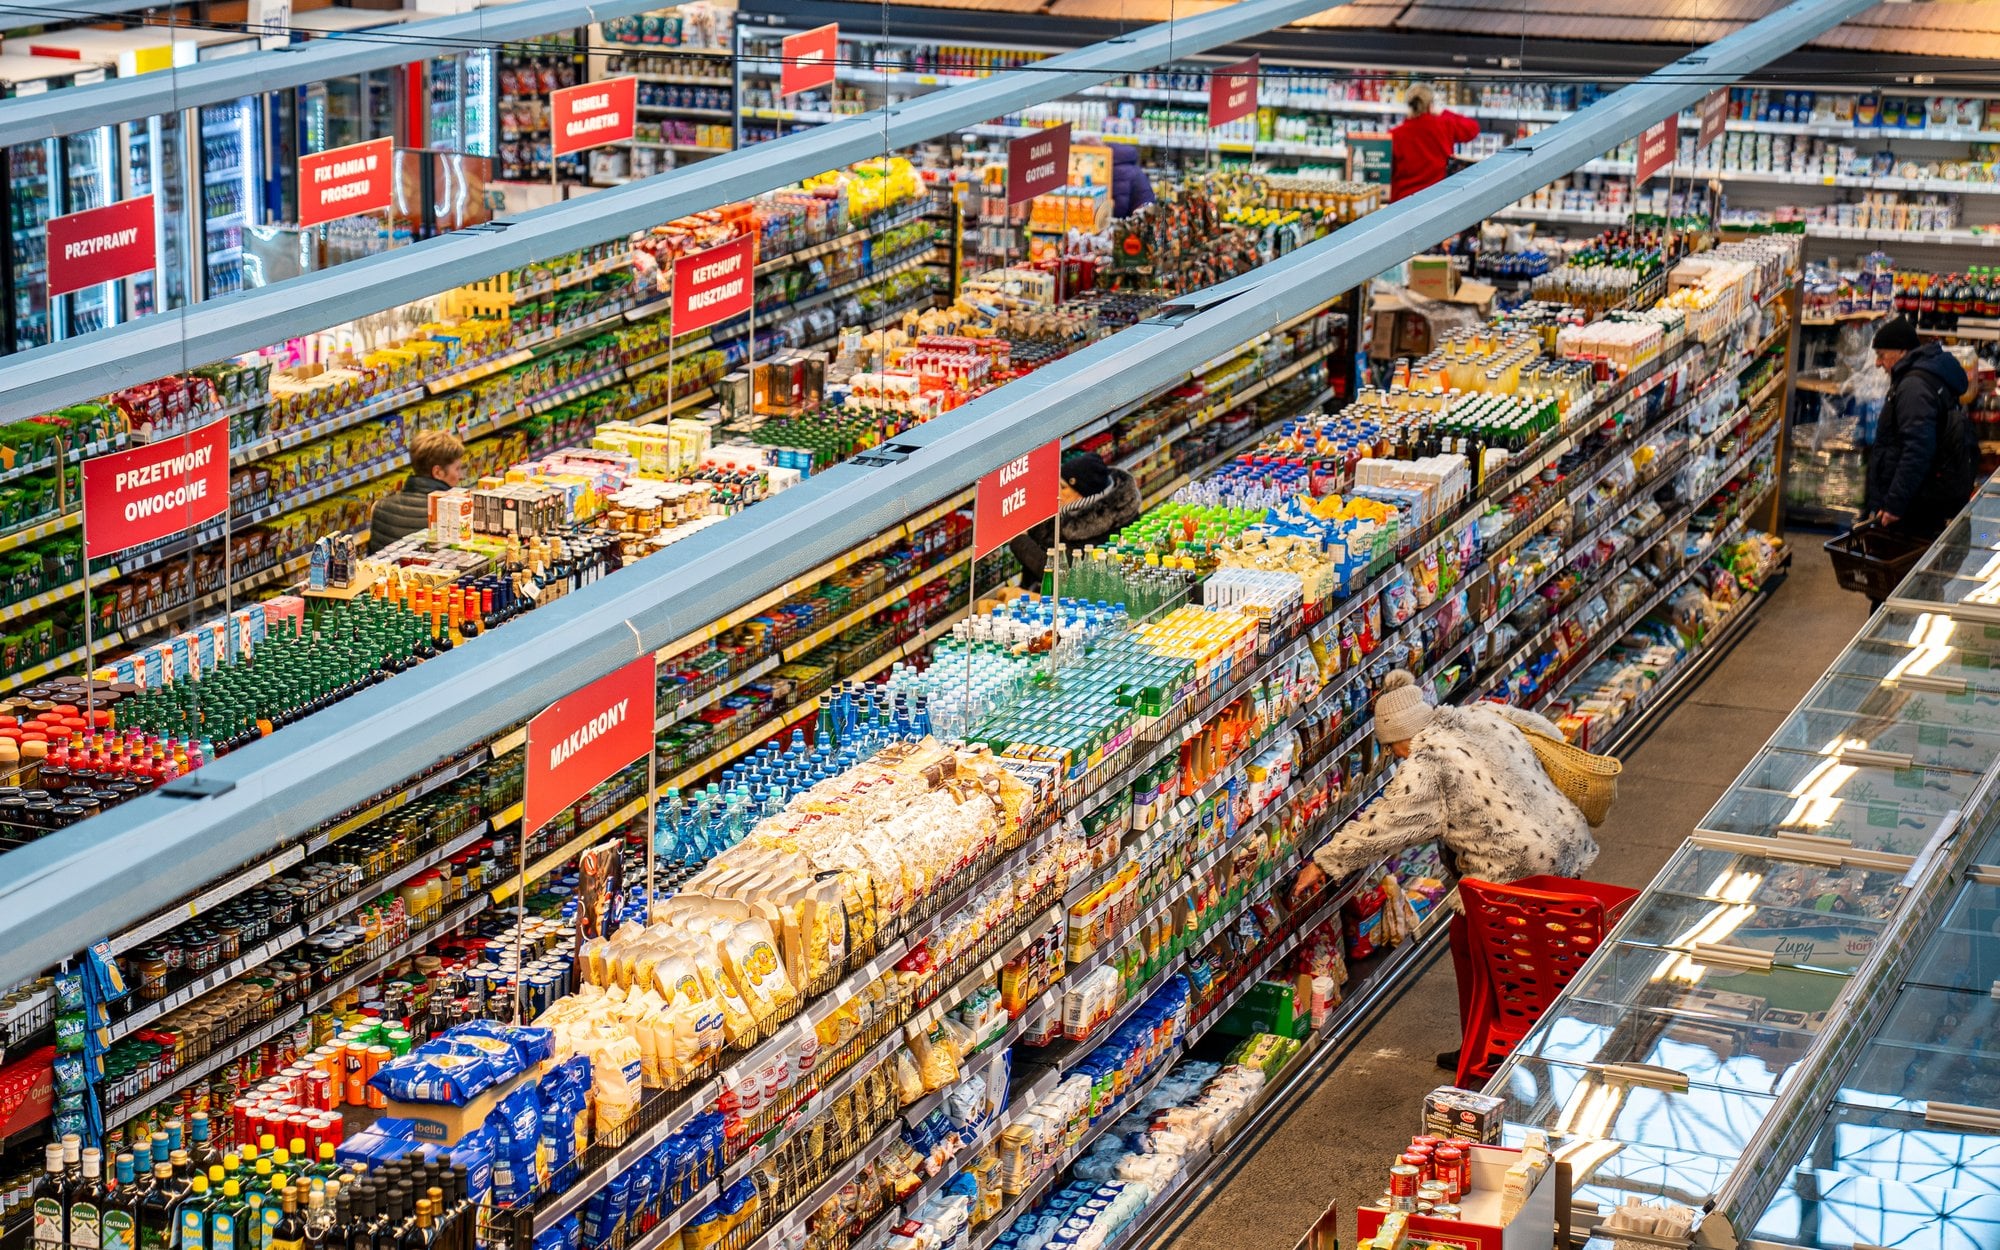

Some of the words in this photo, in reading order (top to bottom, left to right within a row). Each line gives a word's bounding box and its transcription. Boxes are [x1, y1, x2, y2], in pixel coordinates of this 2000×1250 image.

[571, 93, 609, 115] KISIELE
[566, 113, 619, 137] GALARETKI
[1030, 142, 1052, 160] DANIA
[314, 165, 331, 183] FIX
[332, 158, 361, 179] DANIA
[366, 155, 377, 171] W
[1025, 162, 1055, 183] GOTOWE
[320, 181, 370, 205] PROSZKU
[65, 228, 138, 260] PRZYPRAWY
[692, 253, 743, 285] KETCHUPY
[688, 277, 744, 312] MUSZTARDY
[115, 444, 212, 493] PRZETWORY
[999, 455, 1029, 488] KASZE
[124, 482, 207, 522] OWOCOWE
[1002, 487, 1026, 518] RYŻE
[549, 698, 629, 771] MAKARONY
[1774, 936, 1815, 961] Zupy
[31, 1084, 52, 1100] Orla
[36, 1206, 59, 1214] OLITALIA
[73, 1210, 96, 1219] OLITALIA
[105, 1219, 130, 1229] OLITALIA
